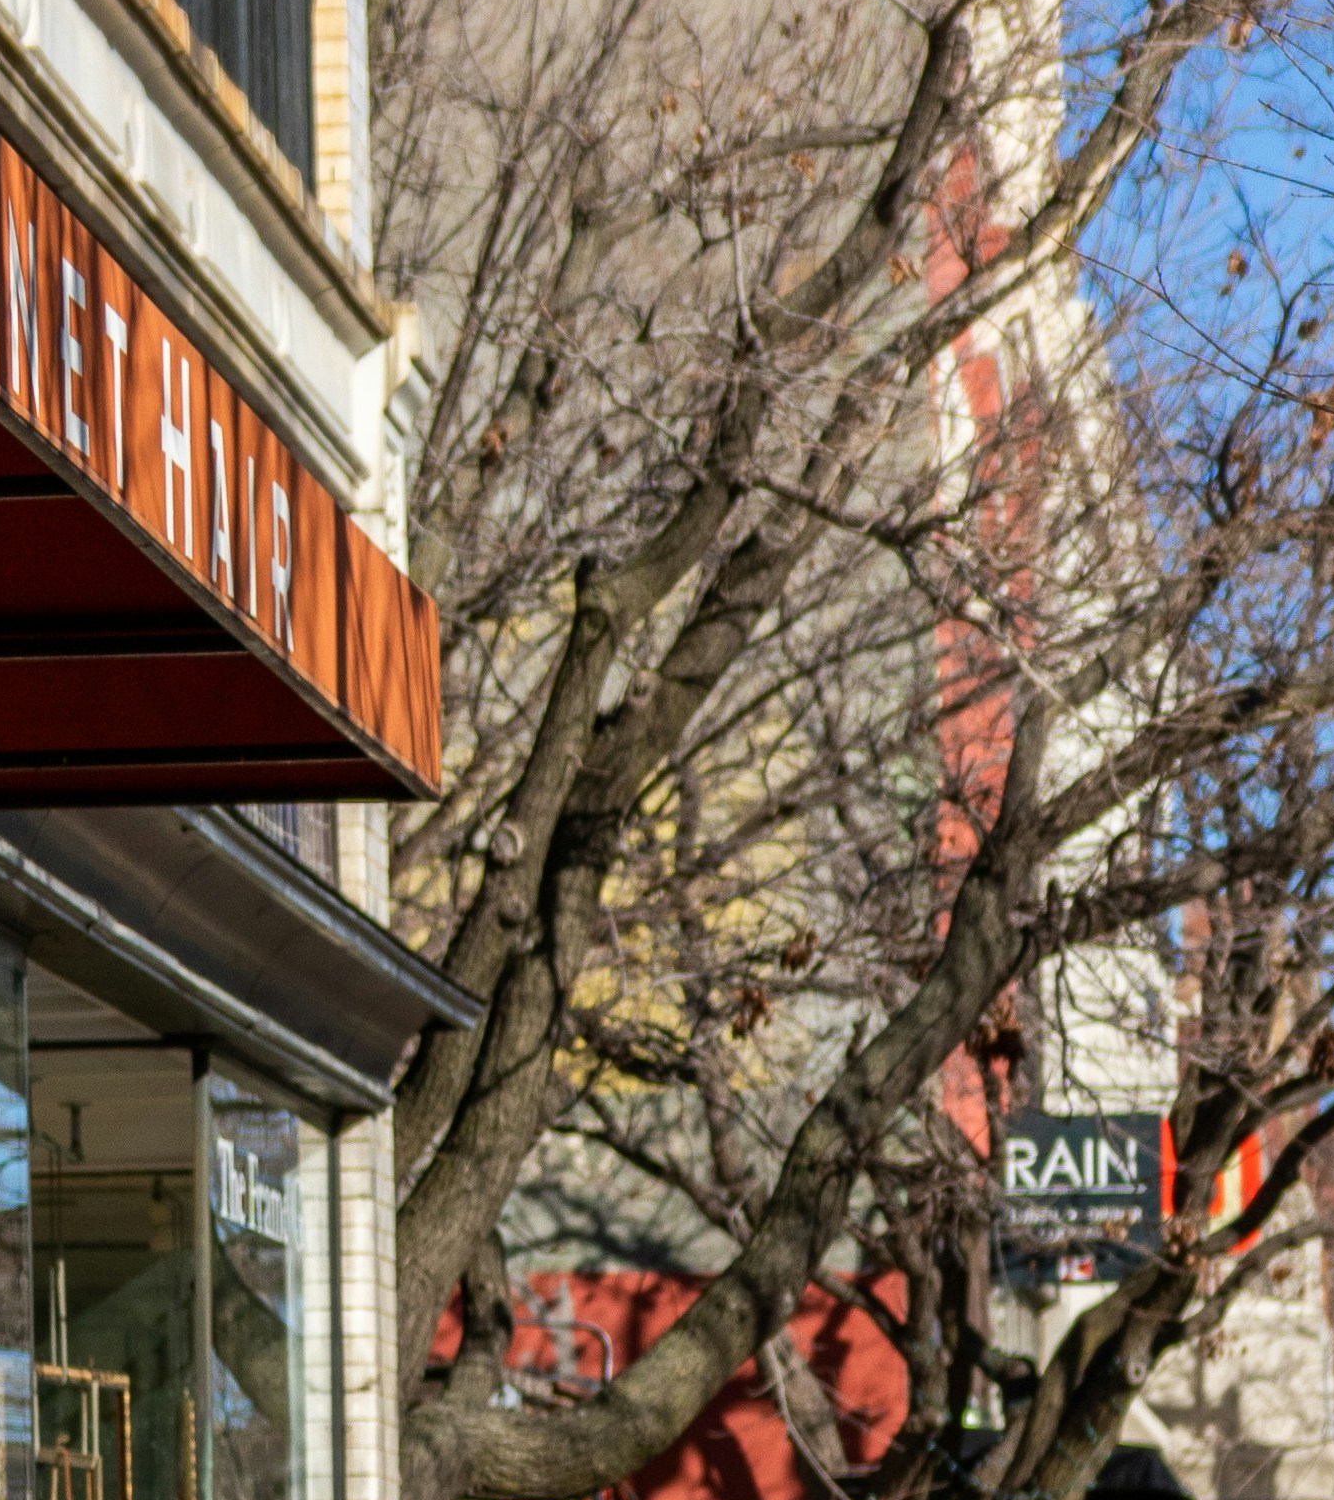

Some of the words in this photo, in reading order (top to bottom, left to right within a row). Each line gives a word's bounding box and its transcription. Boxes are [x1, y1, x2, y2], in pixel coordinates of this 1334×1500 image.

[161, 336, 295, 653] HAIR
[217, 1136, 246, 1227] The
[1005, 1137, 1138, 1188] RAIN
